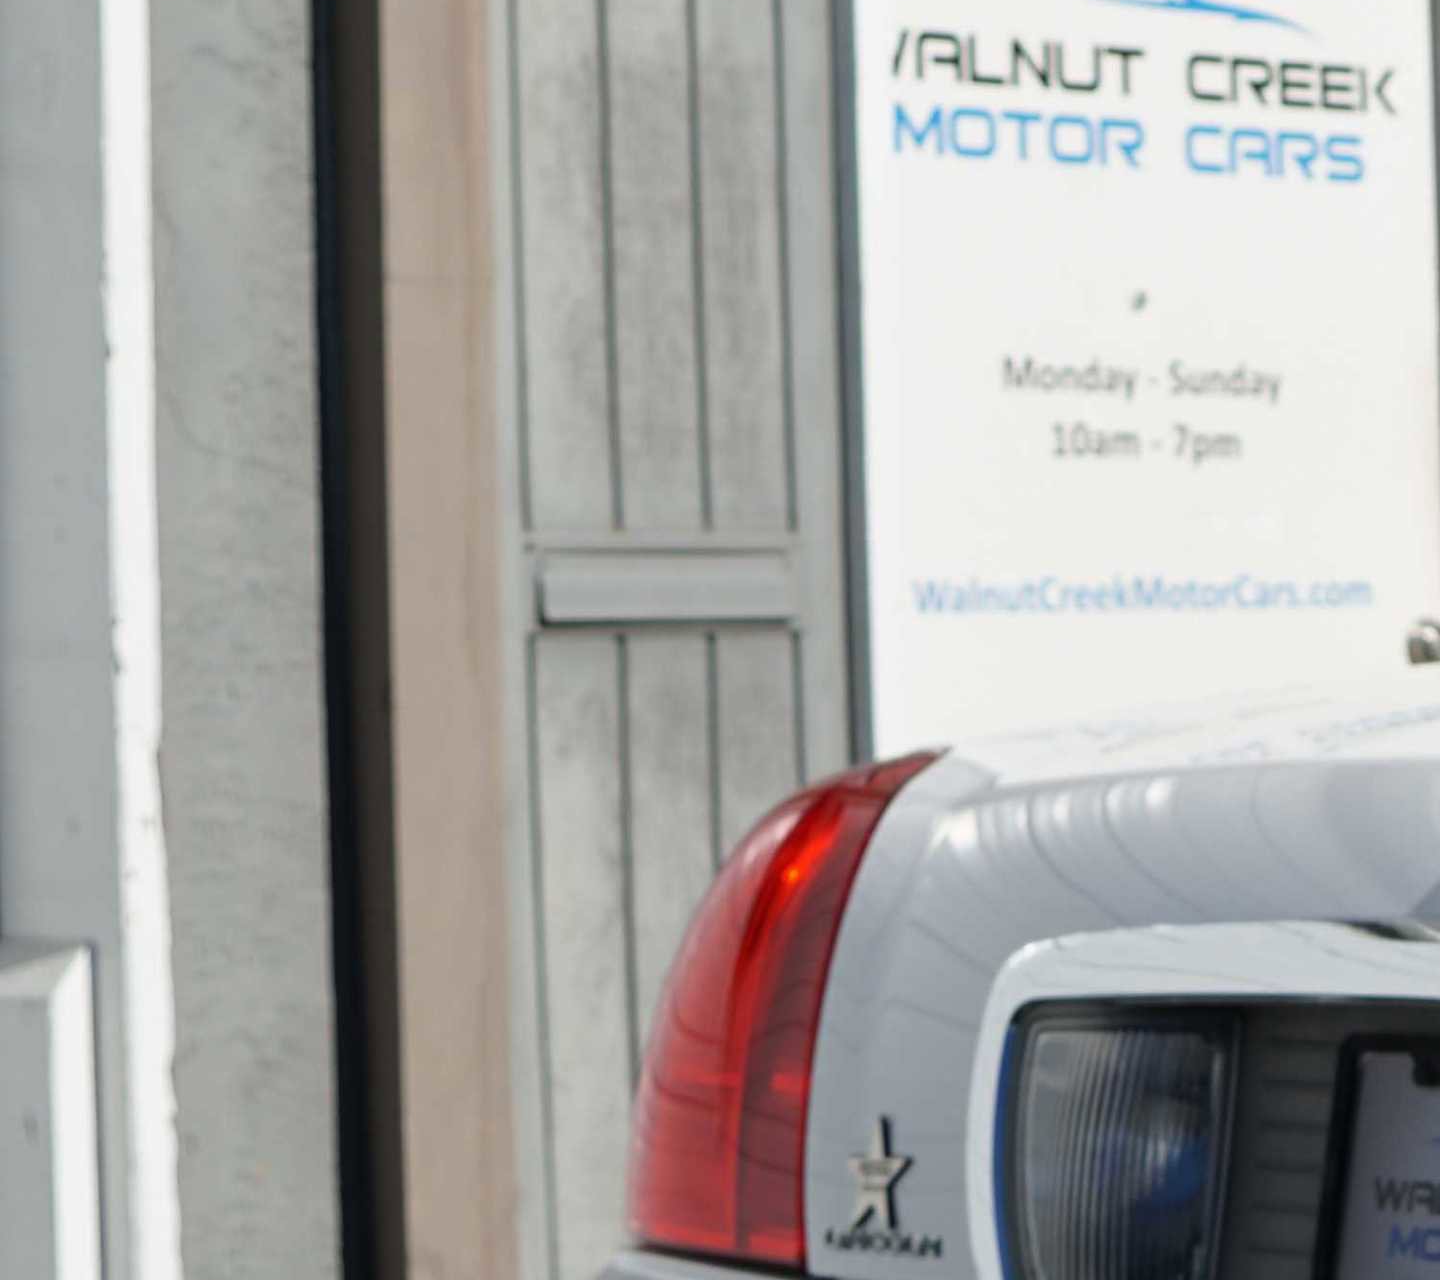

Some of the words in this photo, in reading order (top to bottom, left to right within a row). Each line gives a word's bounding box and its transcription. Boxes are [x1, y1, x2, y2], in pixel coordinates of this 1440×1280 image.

[1187, 53, 1397, 115] CREEK
[892, 104, 1145, 168] MOTOR
[1186, 125, 1367, 183] CARS
[1003, 357, 1138, 401] Monday
[1169, 360, 1282, 405] Sunday
[1053, 421, 1140, 458] 10am
[1173, 423, 1243, 466] 7pm
[912, 577, 1374, 614] WalnutCreekMotorCars.com
